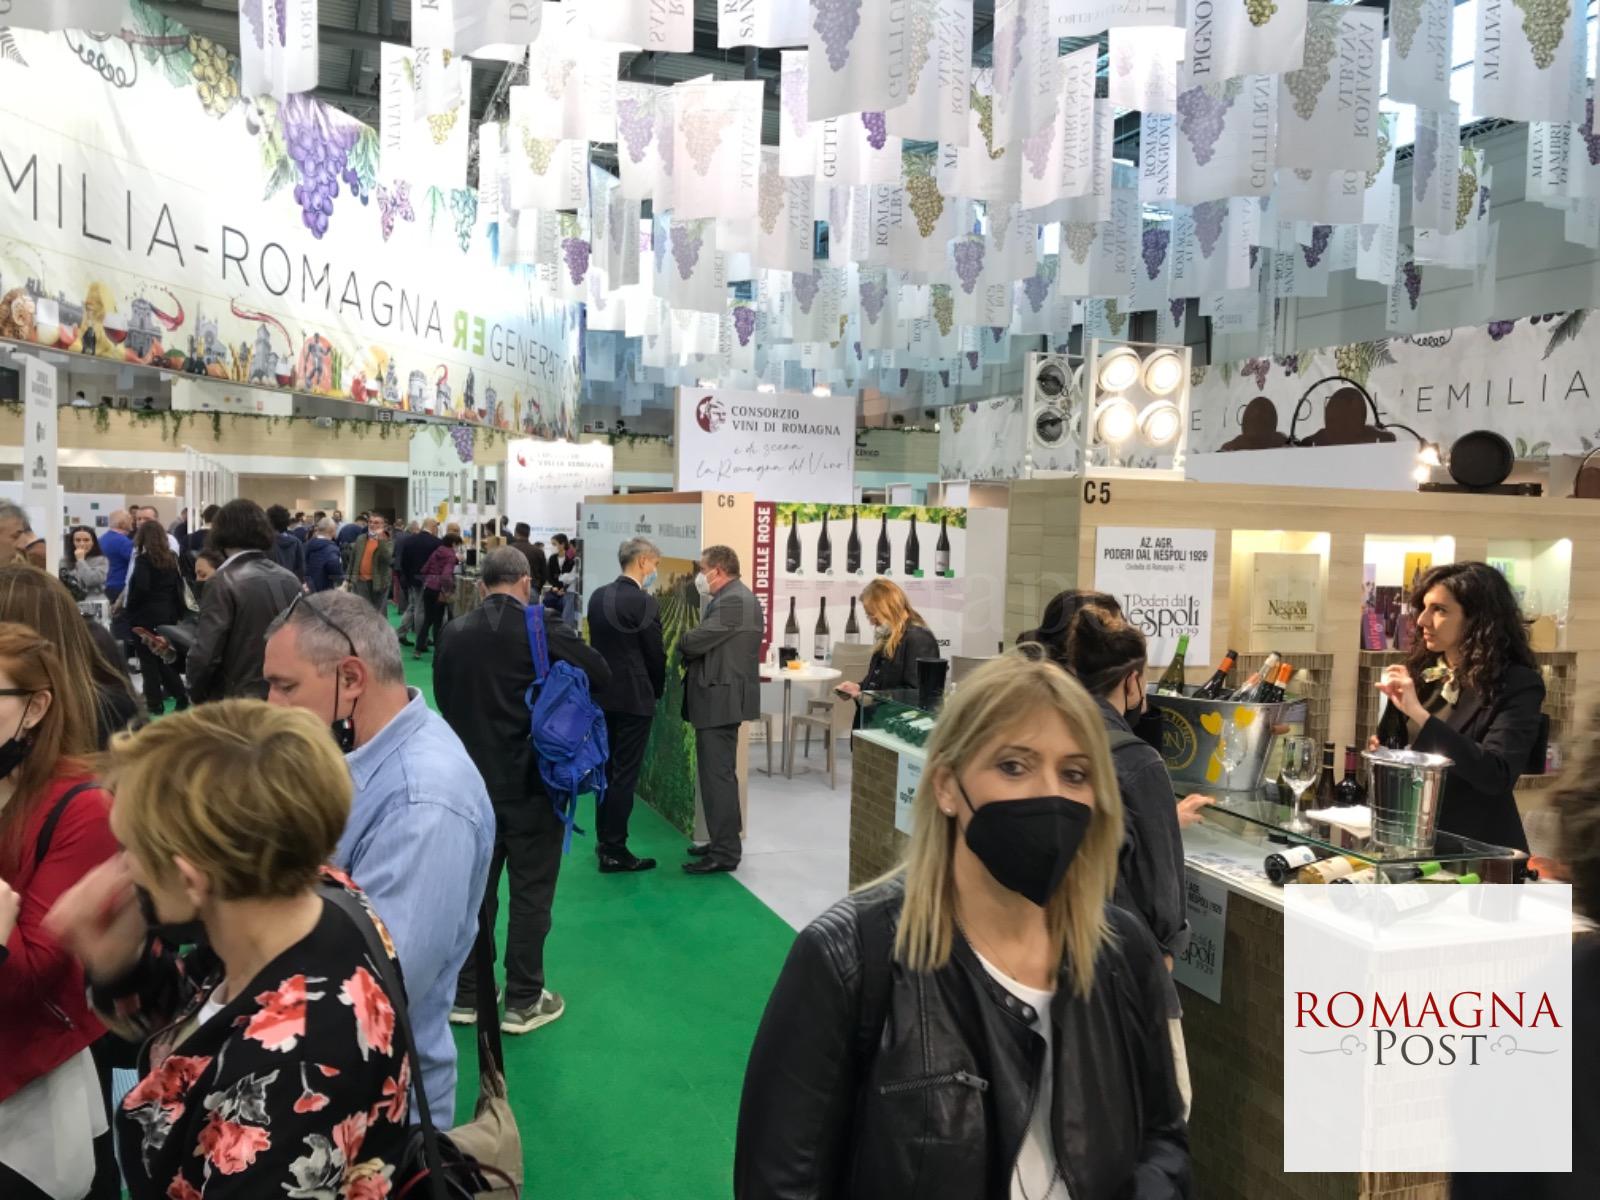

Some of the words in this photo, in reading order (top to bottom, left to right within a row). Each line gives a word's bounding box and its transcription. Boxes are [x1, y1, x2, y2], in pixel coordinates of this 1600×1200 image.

[1192, 0, 1214, 76] PIGNO
[1482, 0, 1501, 81] MALVA
[731, 405, 800, 420] CONSORZIO
[732, 420, 758, 432] VINI
[764, 421, 776, 433] DI
[781, 423, 841, 436] ROMAGNA
[1083, 480, 1112, 505] C5
[717, 494, 736, 508] C6
[757, 506, 771, 543] ROSE
[1139, 536, 1152, 549] AZ.
[1154, 536, 1174, 549] AGR.
[1104, 549, 1135, 560] PODERI
[1135, 549, 1151, 561] DAL
[1153, 550, 1187, 561] NESPOLI
[1189, 550, 1209, 562] 1929
[756, 546, 770, 589] DELLE
[1132, 593, 1169, 607] Poderi
[1170, 594, 1187, 607] dal
